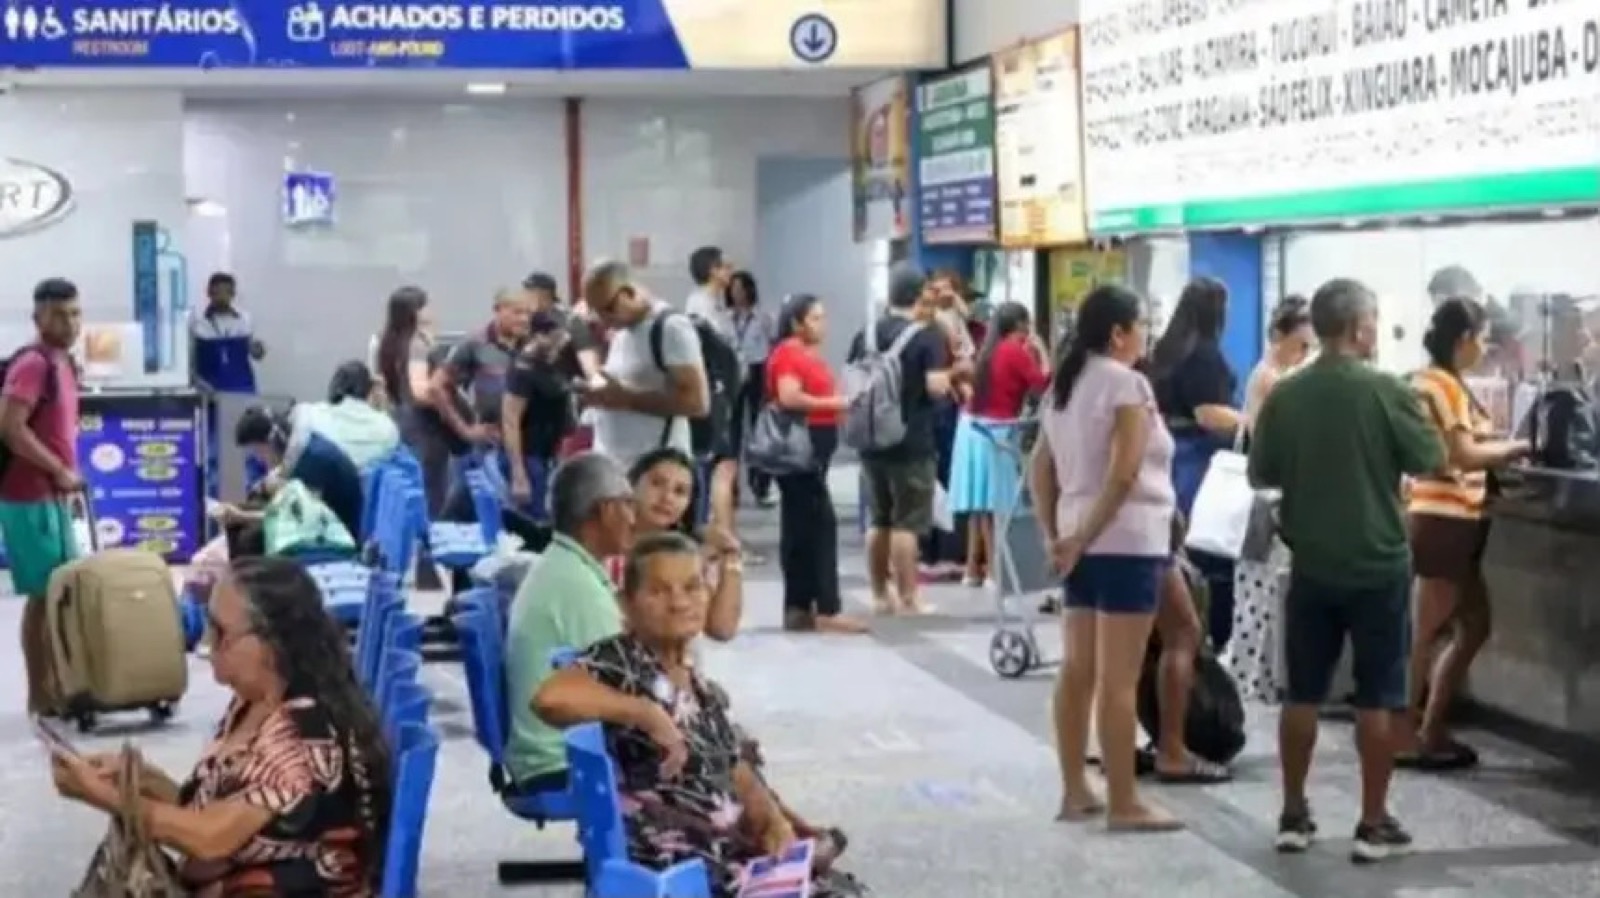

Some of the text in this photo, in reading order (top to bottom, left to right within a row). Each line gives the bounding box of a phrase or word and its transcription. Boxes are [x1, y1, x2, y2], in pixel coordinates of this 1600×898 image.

[72, 2, 240, 34] SANITÁRIOS
[330, 4, 625, 30] ACHADOS E PERDIDOS
[1342, 55, 1439, 117] XINGUARA
[1450, 28, 1568, 98] MOCAJUBA
